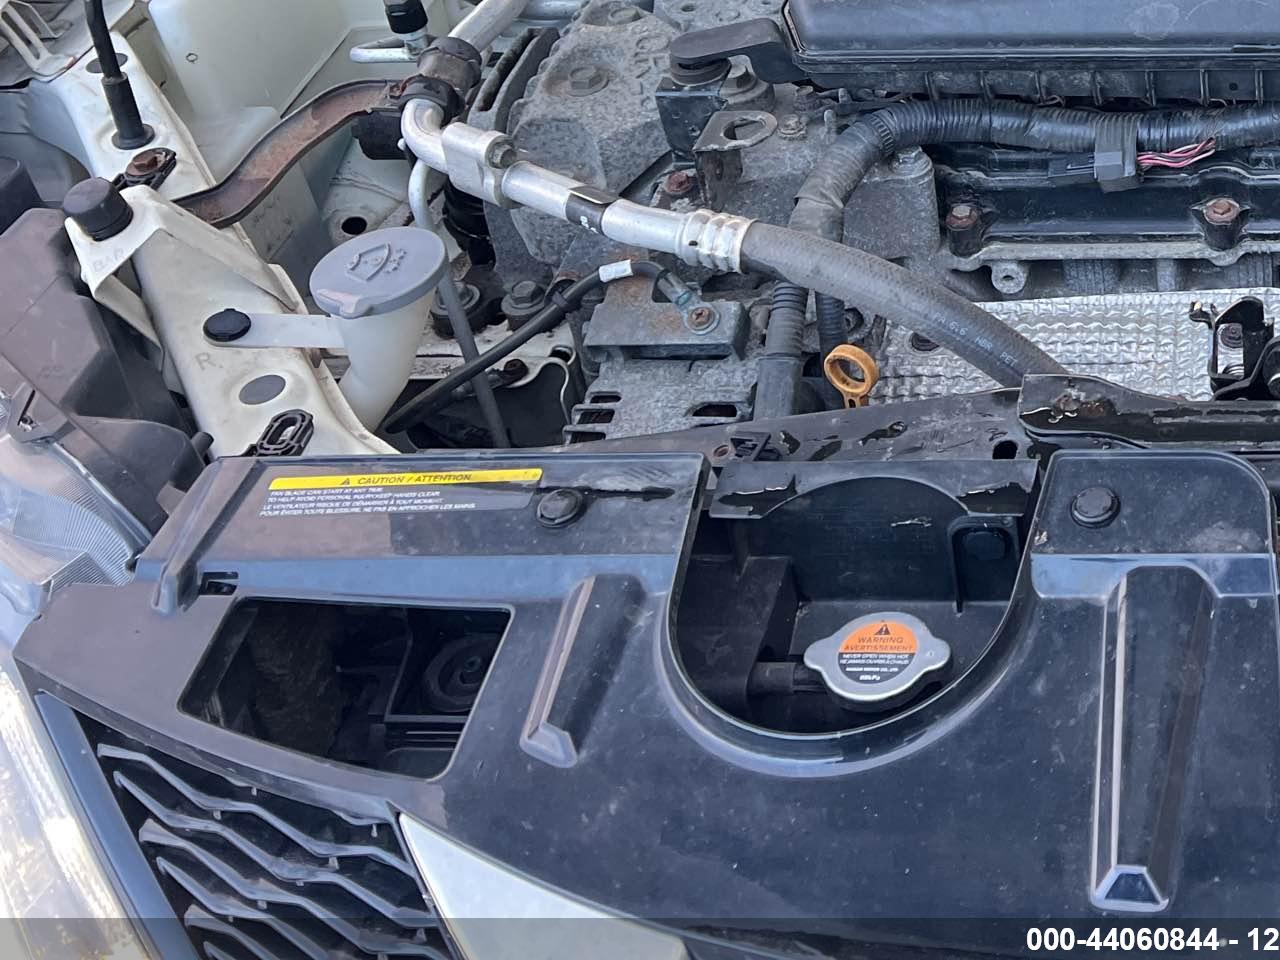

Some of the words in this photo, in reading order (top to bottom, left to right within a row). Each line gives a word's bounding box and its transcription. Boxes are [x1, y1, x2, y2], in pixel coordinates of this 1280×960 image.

[358, 476, 404, 485] CAUTION
[415, 474, 472, 482] ATTENTION
[857, 636, 904, 644] WARNING
